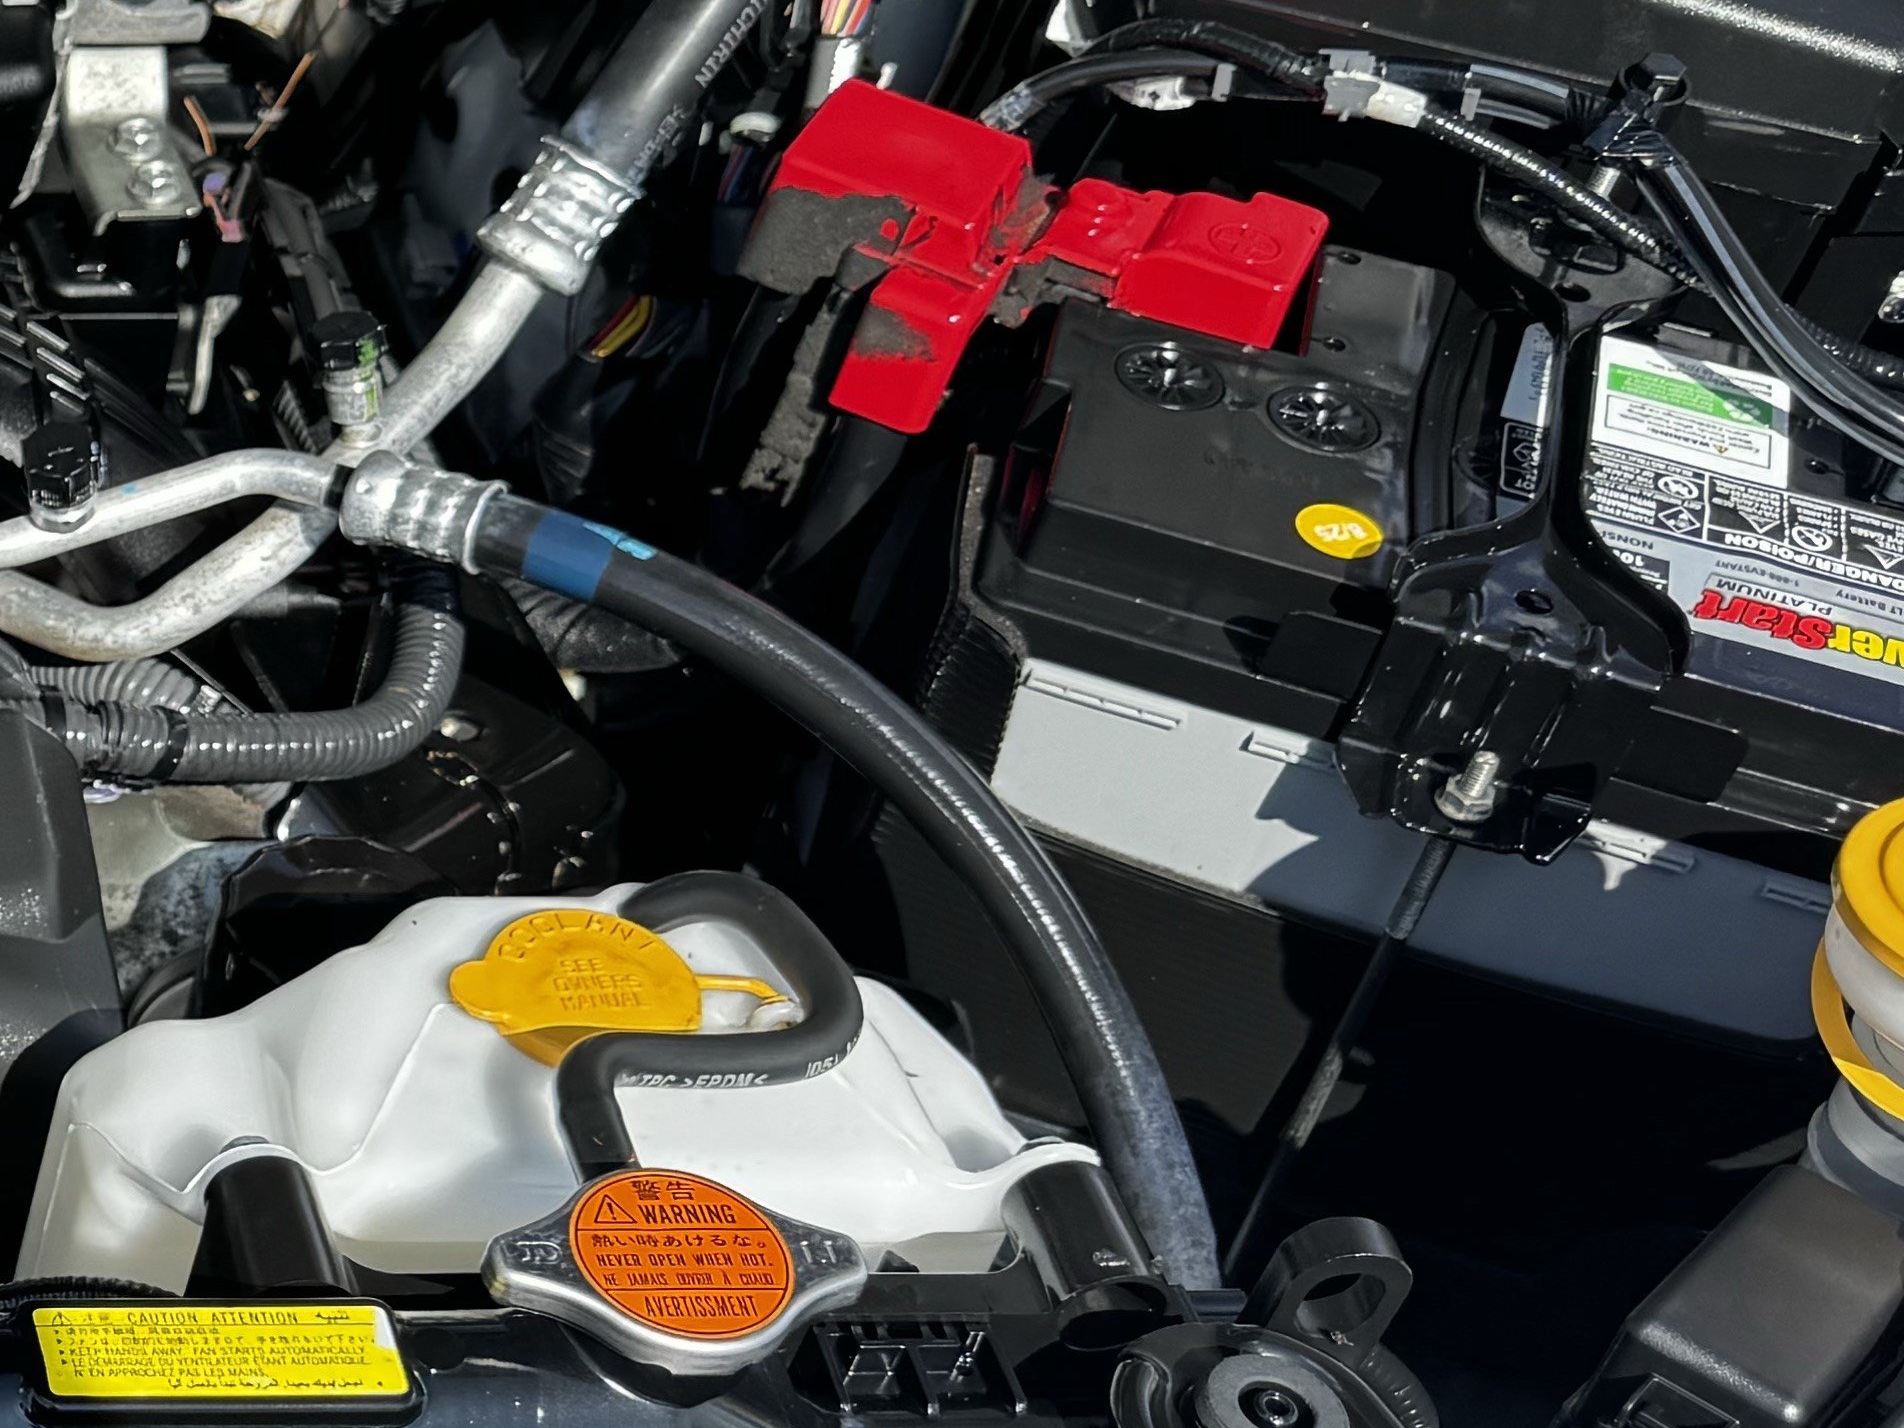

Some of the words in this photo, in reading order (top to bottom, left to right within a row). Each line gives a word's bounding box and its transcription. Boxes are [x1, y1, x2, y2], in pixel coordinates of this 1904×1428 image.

[1717, 579, 1832, 615] PLATINUM
[1836, 591, 1886, 613] Battery
[498, 913, 656, 960] COOLANT
[560, 959, 603, 972] SEE
[553, 975, 643, 992] OWNERS
[559, 995, 649, 1012] MANUAL
[630, 1179, 695, 1201] 警告
[638, 1204, 736, 1225] WARNING
[596, 1253, 642, 1266] NEVER
[648, 1253, 686, 1266] OPEN
[692, 1253, 733, 1266] WHEN
[740, 1253, 773, 1266] HOT.
[604, 1273, 619, 1286] NE
[644, 1295, 759, 1318] AVERTISSMENT
[127, 1312, 199, 1323] CAUTION
[211, 1312, 298, 1323] ATTENTION
[193, 1347, 219, 1356] FAN
[71, 1357, 85, 1368] LE
[159, 1357, 174, 1367] DU
